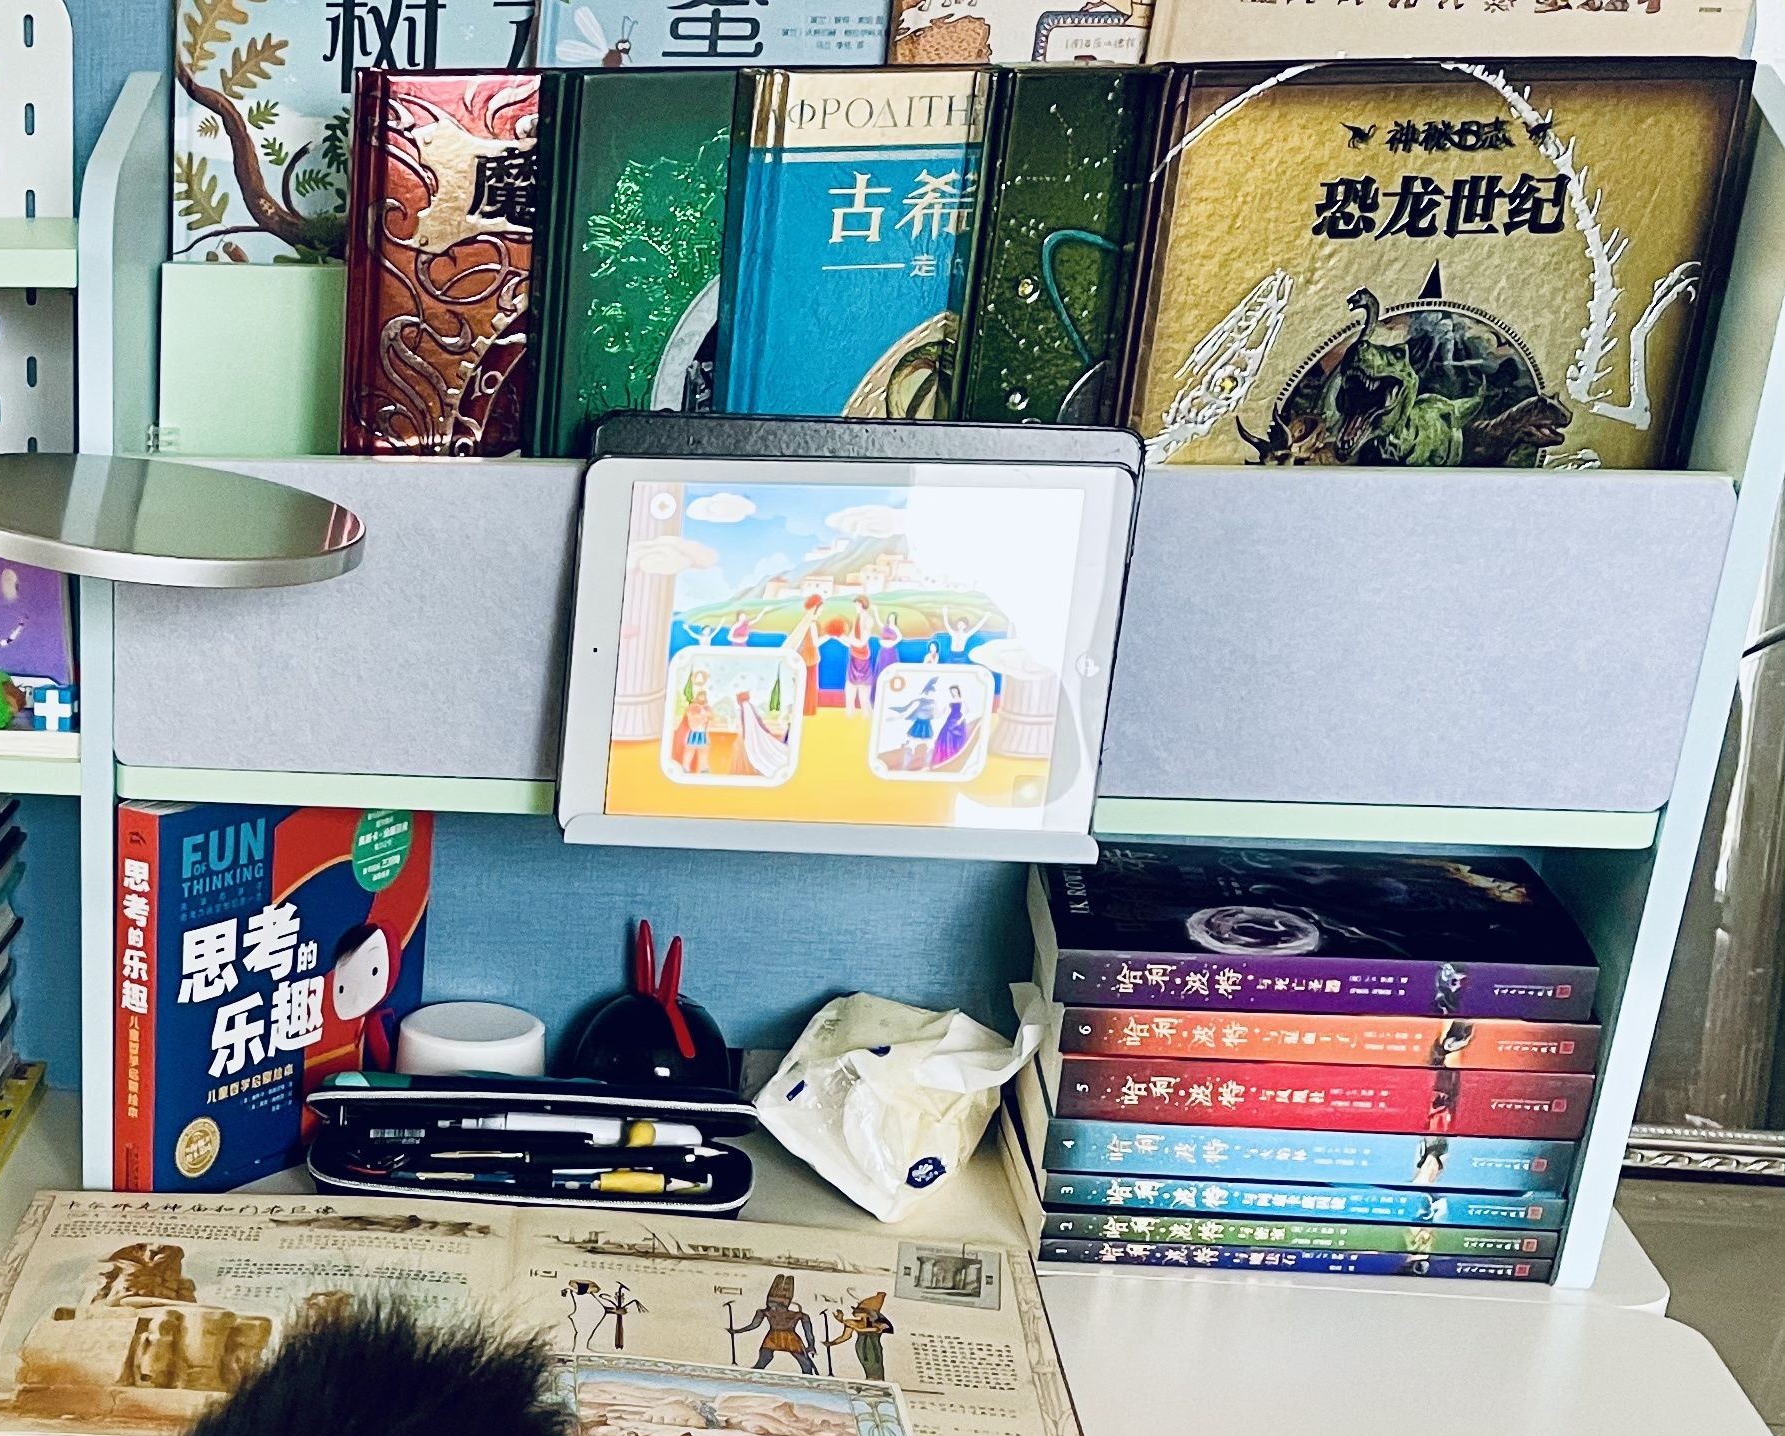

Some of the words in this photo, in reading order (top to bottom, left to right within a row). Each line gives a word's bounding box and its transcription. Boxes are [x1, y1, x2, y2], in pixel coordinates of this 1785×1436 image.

[1386, 118, 1515, 153] 神秘日志
[1312, 172, 1573, 242] 恐龙世纪
[182, 817, 266, 879] FUN
[182, 862, 264, 898] THINKING
[193, 862, 207, 875] OF
[120, 858, 150, 1014] 思考的乐趣
[177, 902, 318, 1004] 思考的
[1072, 972, 1086, 981] 7
[207, 975, 326, 1078] 乐趣
[1078, 1025, 1092, 1035] 6
[1076, 1083, 1089, 1093] 5
[1062, 1139, 1075, 1149] 4
[1060, 1185, 1074, 1195] 3
[1060, 1221, 1073, 1231] 2
